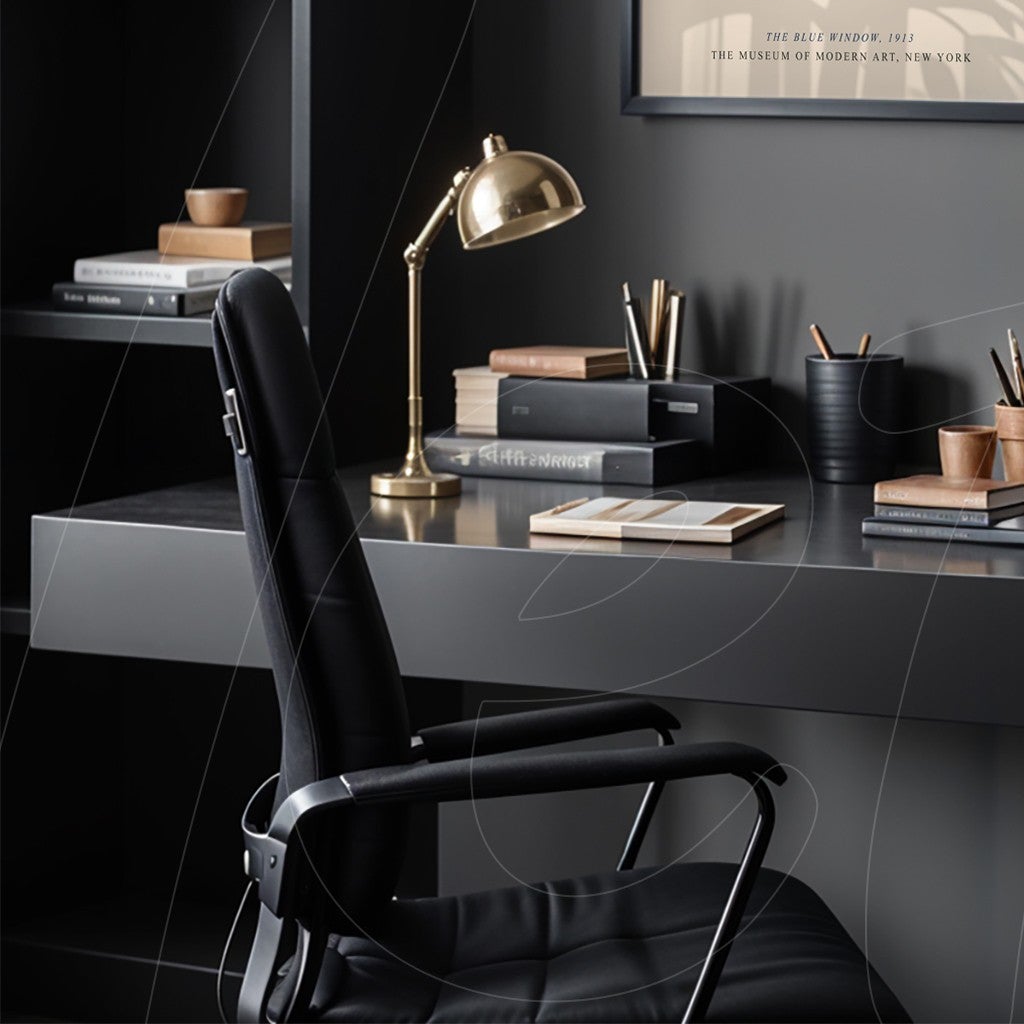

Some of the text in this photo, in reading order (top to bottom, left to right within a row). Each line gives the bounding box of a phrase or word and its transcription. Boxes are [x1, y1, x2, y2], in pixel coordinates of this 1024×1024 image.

[766, 32, 914, 44] THE BLUE WINDOW, 1913
[711, 50, 972, 63] THE MUSEUM OF MODERN ART, NEW YORK
